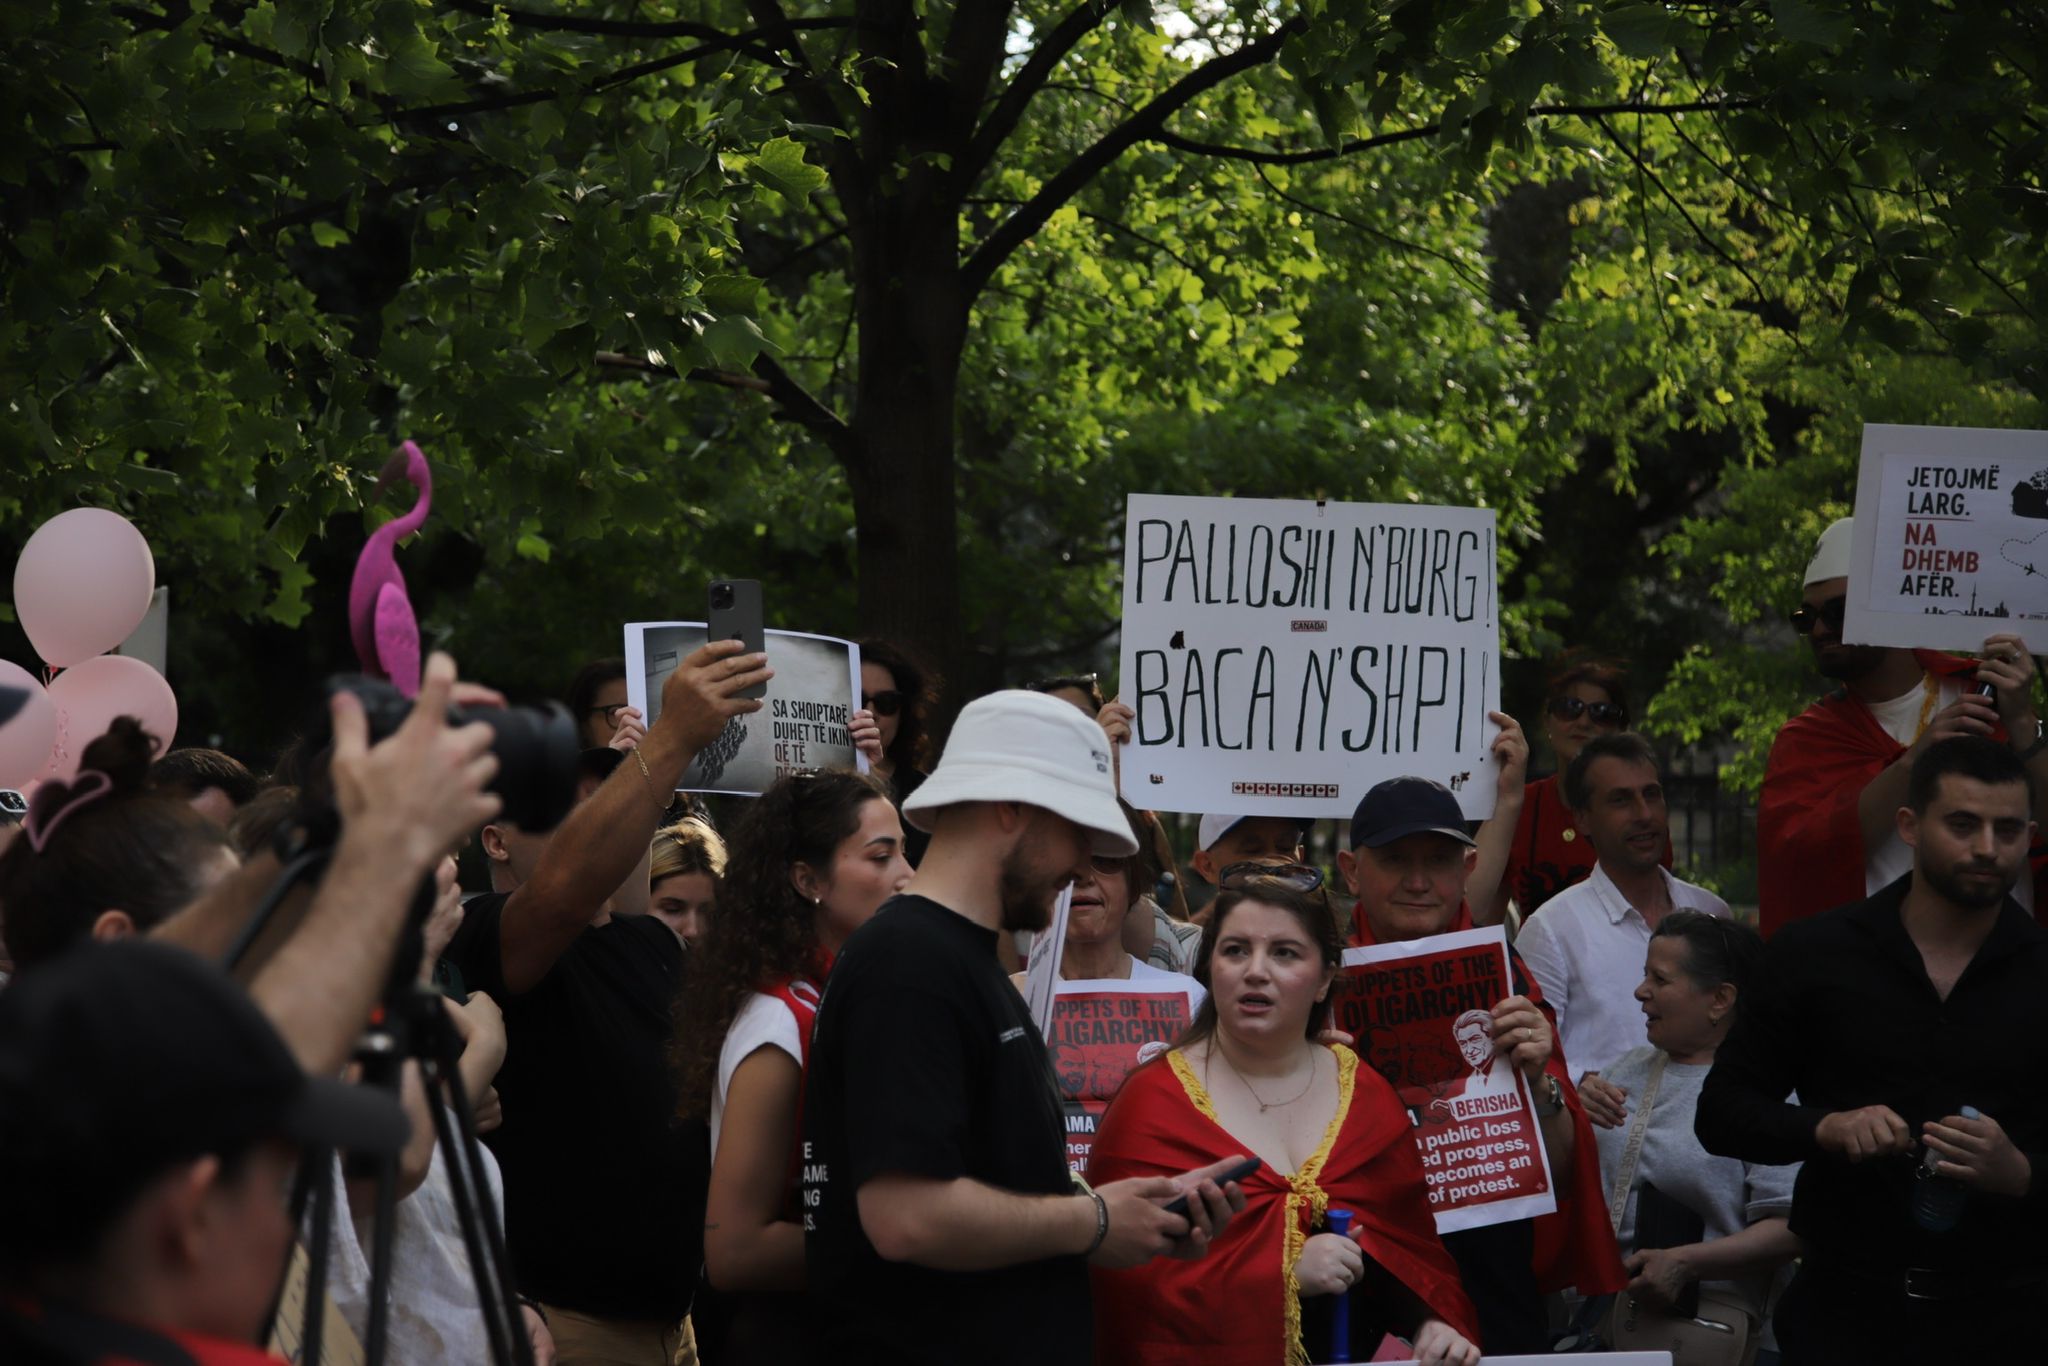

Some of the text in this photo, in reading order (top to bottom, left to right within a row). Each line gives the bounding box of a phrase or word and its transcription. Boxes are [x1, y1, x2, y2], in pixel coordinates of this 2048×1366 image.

[1907, 465, 2000, 490] JETOJMË
[1908, 492, 1970, 516] LARG.
[1904, 523, 1937, 546] NA
[1135, 519, 1335, 611] PALLOSHI
[1902, 549, 1979, 573] DHEMB
[1900, 572, 1959, 597] AFËR.
[1293, 622, 1325, 630] CANADA
[1135, 645, 1275, 751] BACA
[773, 699, 848, 725] SA SHQIPTARË
[774, 722, 850, 747] DUHET TË IKIN
[775, 740, 806, 764] QË TË
[1432, 959, 1454, 985] OF
[1462, 953, 1497, 978] THE
[1119, 999, 1141, 1018] OF
[1148, 1000, 1182, 1019] THE
[1343, 979, 1500, 1032] OLIGARCHY!
[1455, 1092, 1520, 1117] BERISHA
[1426, 1125, 1482, 1151] public
[1484, 1120, 1521, 1137] loss
[1622, 1124, 1645, 1169] CHANGE
[1445, 1139, 1531, 1166] progress,
[1509, 1155, 1532, 1170] an
[1428, 1175, 1521, 1204] of protest.
